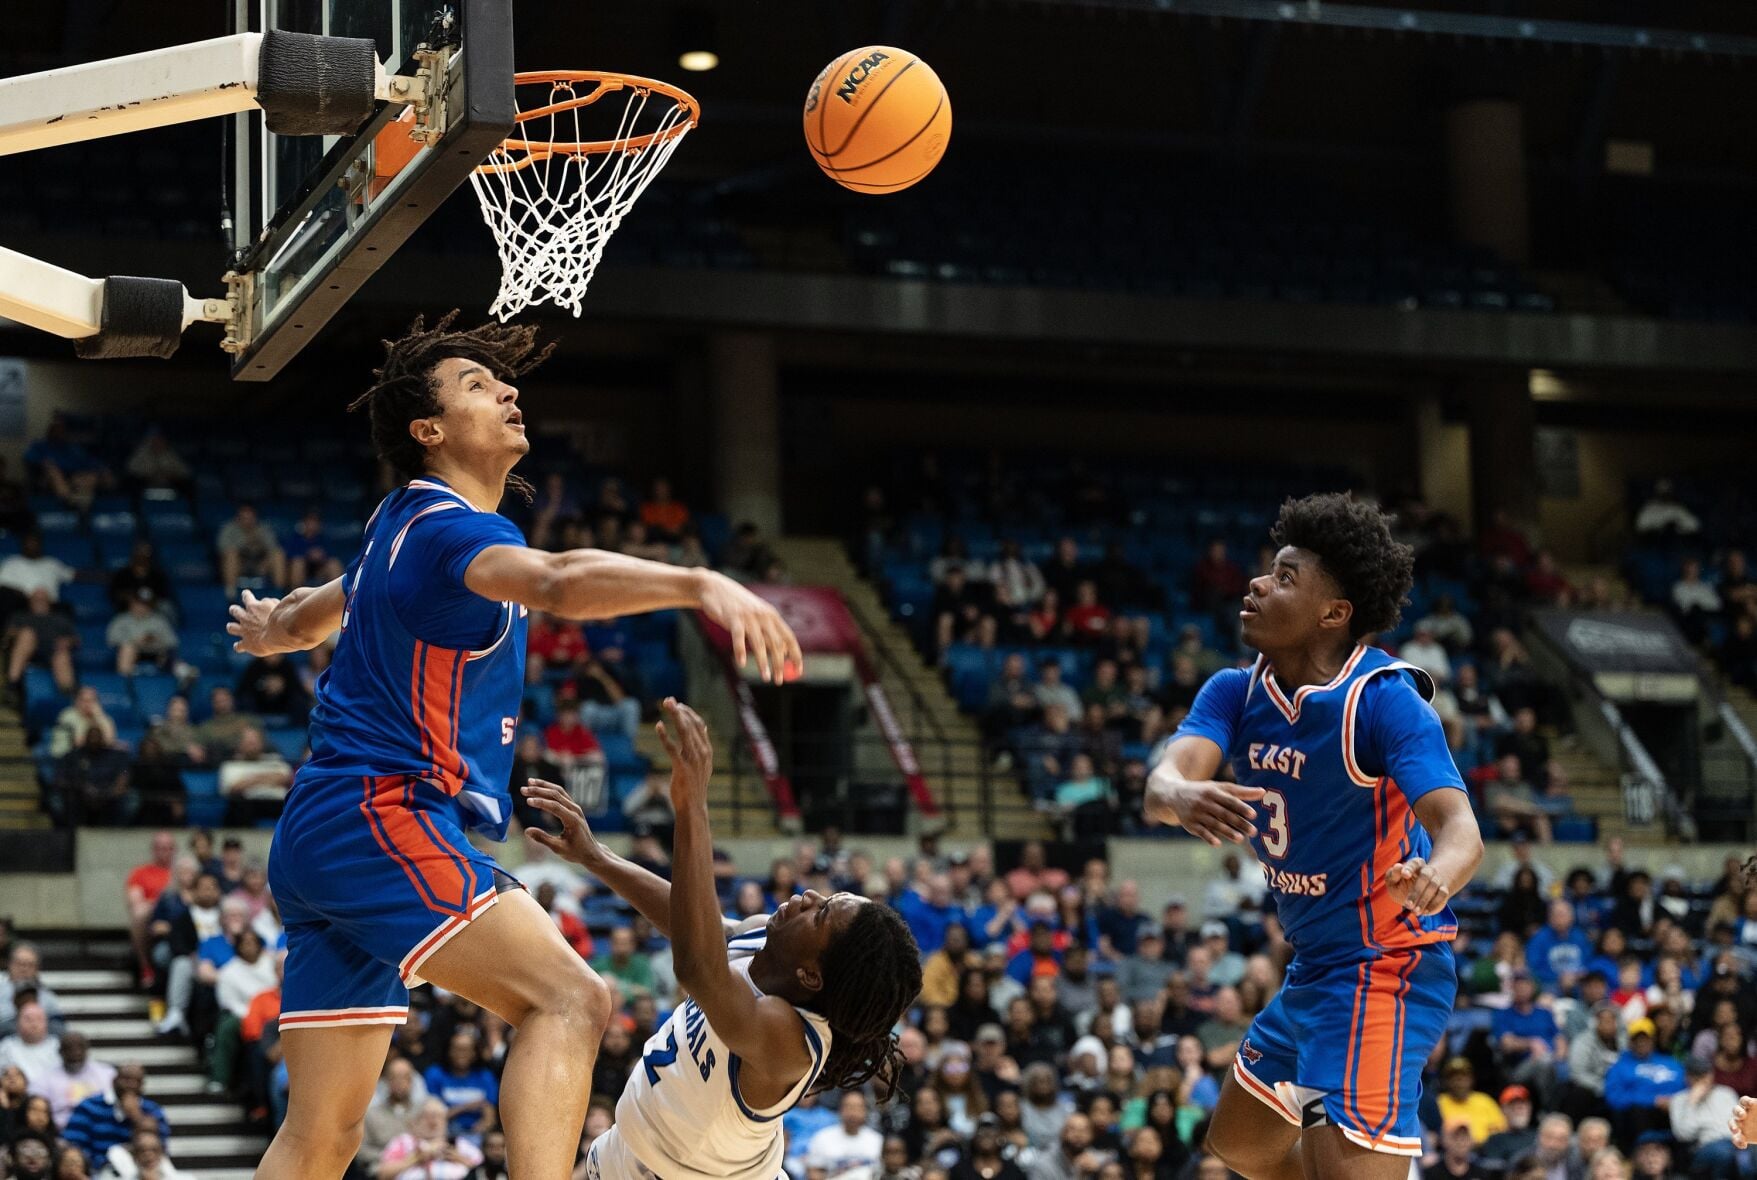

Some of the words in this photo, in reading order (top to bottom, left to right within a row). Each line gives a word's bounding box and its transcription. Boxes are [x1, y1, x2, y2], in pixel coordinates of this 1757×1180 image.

[836, 51, 889, 104] NCAA
[1248, 743, 1306, 780] EAST
[1261, 788, 1290, 859] 3
[643, 1024, 678, 1088] 2
